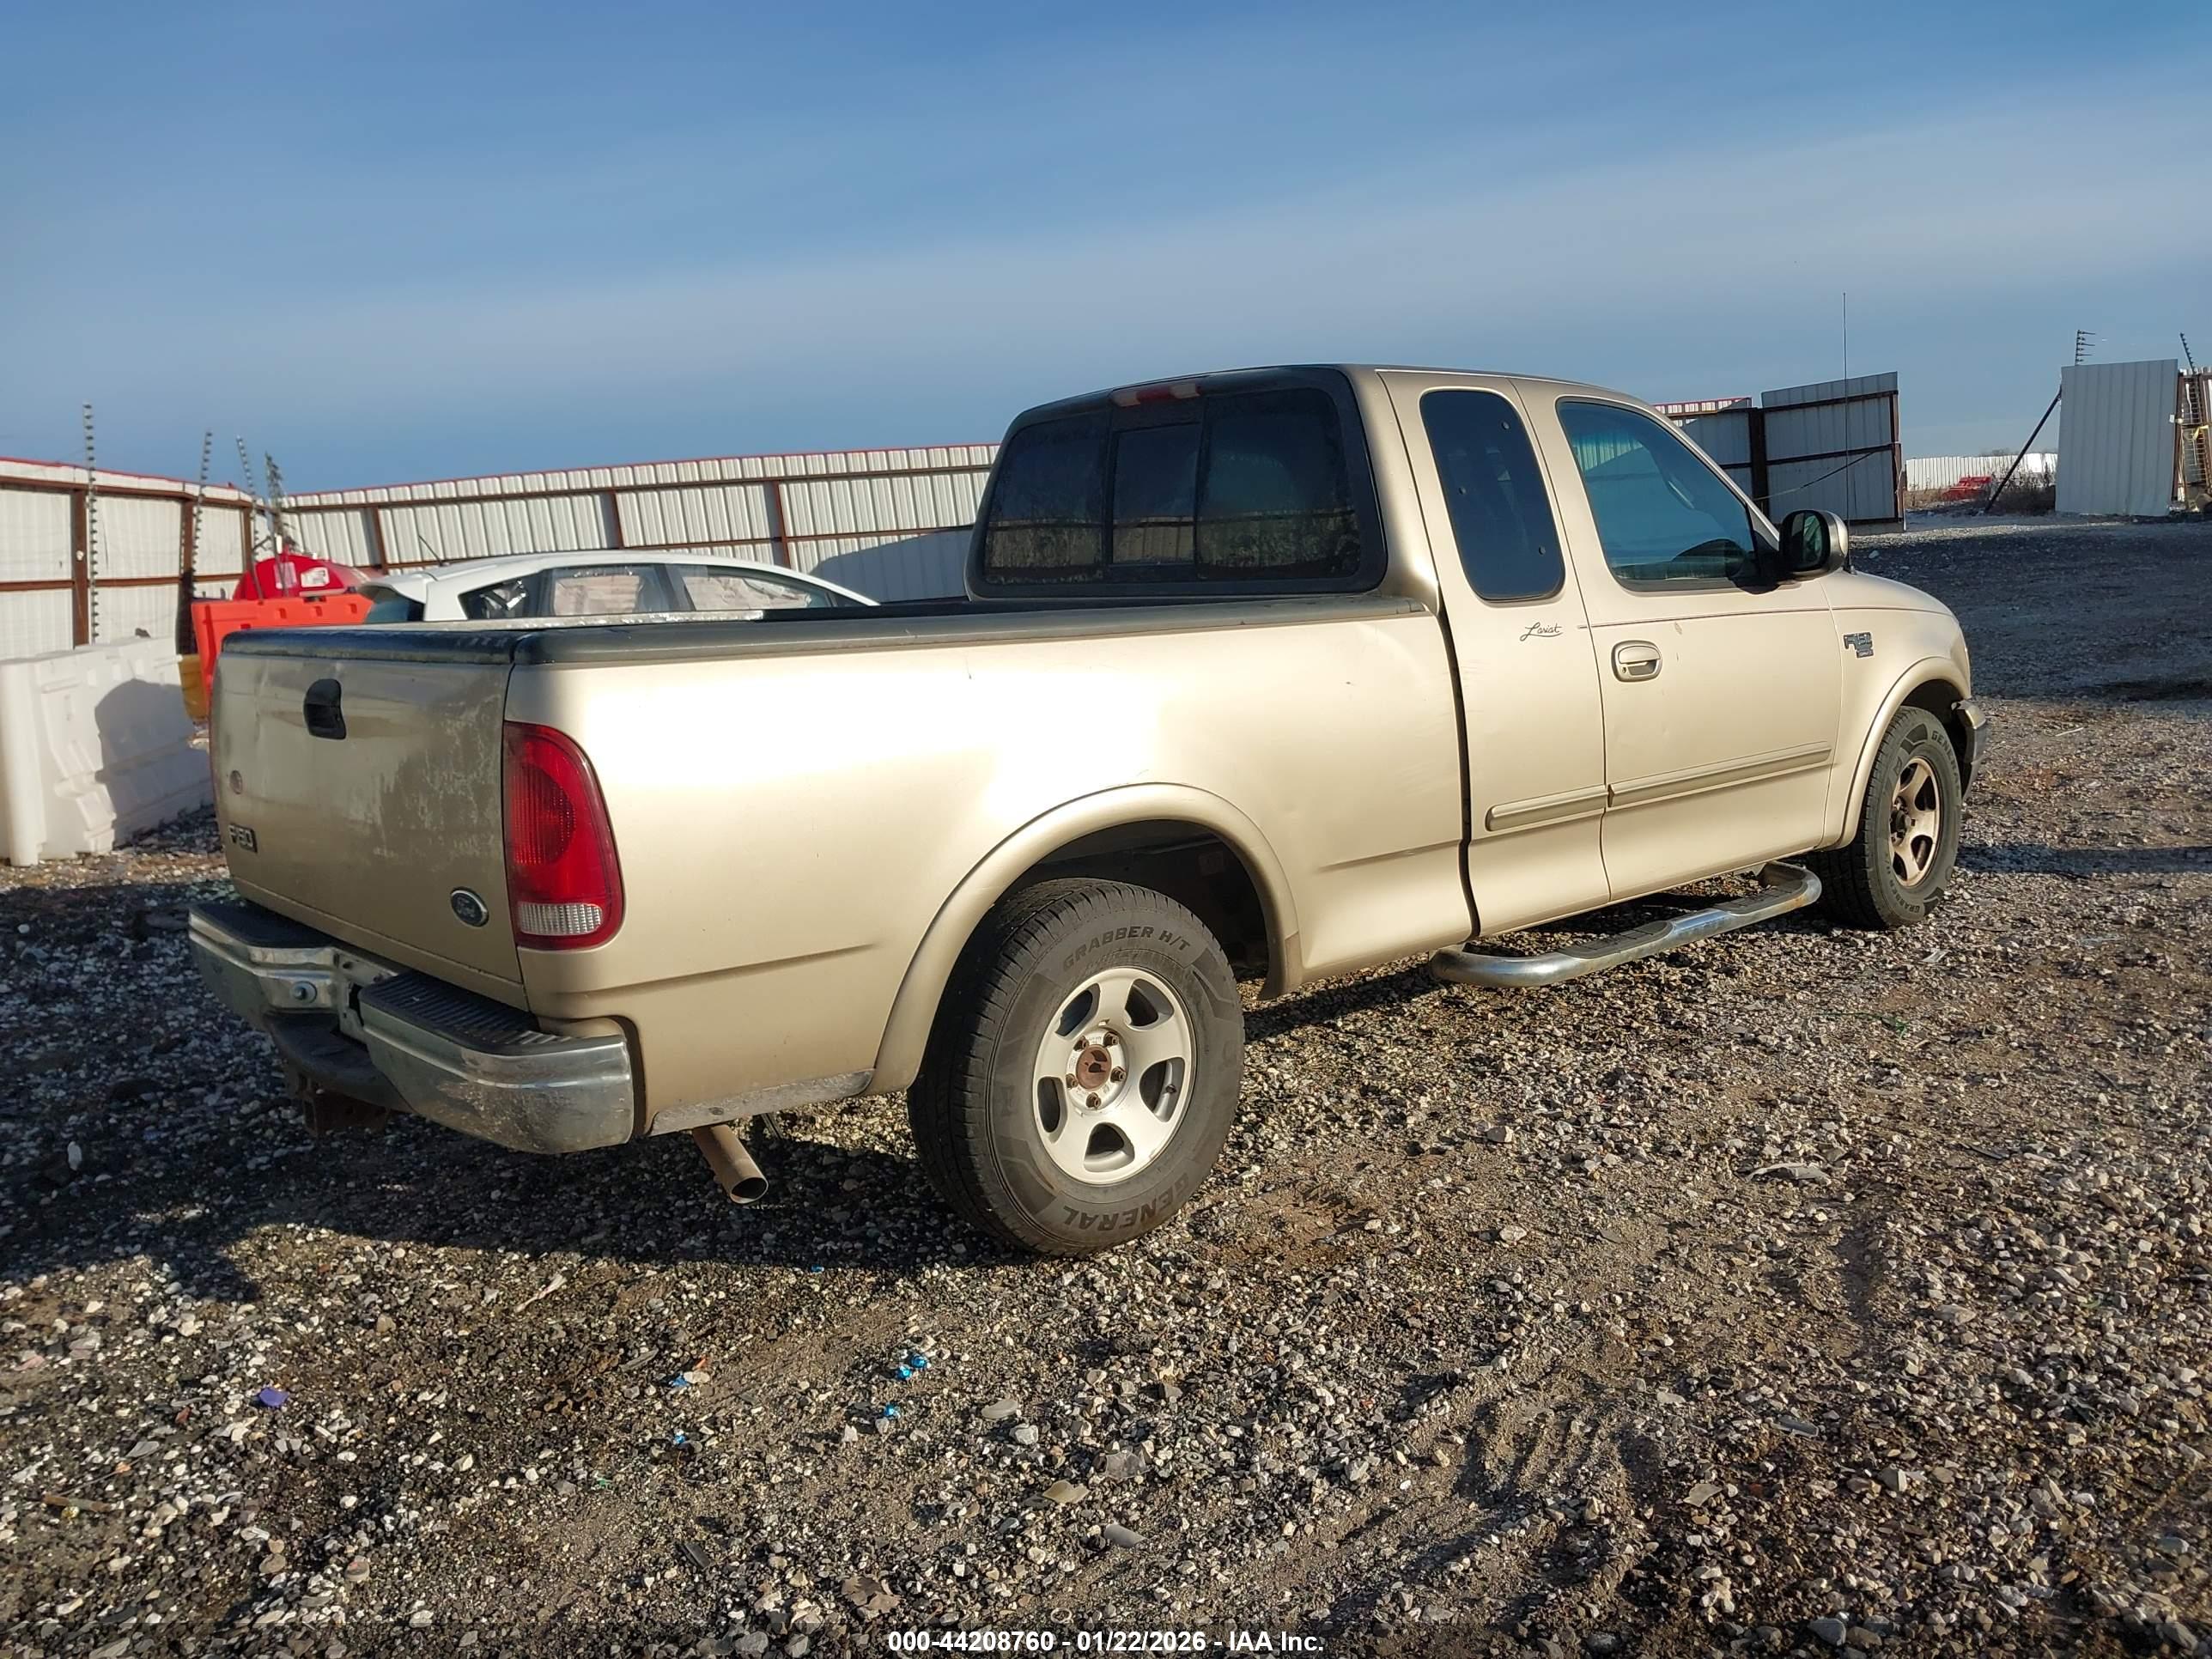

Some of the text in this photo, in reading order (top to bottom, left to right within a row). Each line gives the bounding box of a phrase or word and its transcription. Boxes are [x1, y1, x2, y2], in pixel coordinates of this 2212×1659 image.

[1520, 622, 1564, 641] Lariat
[1063, 926, 1190, 971] GRABBER H/T
[1063, 1172, 1189, 1231] GENERAL
